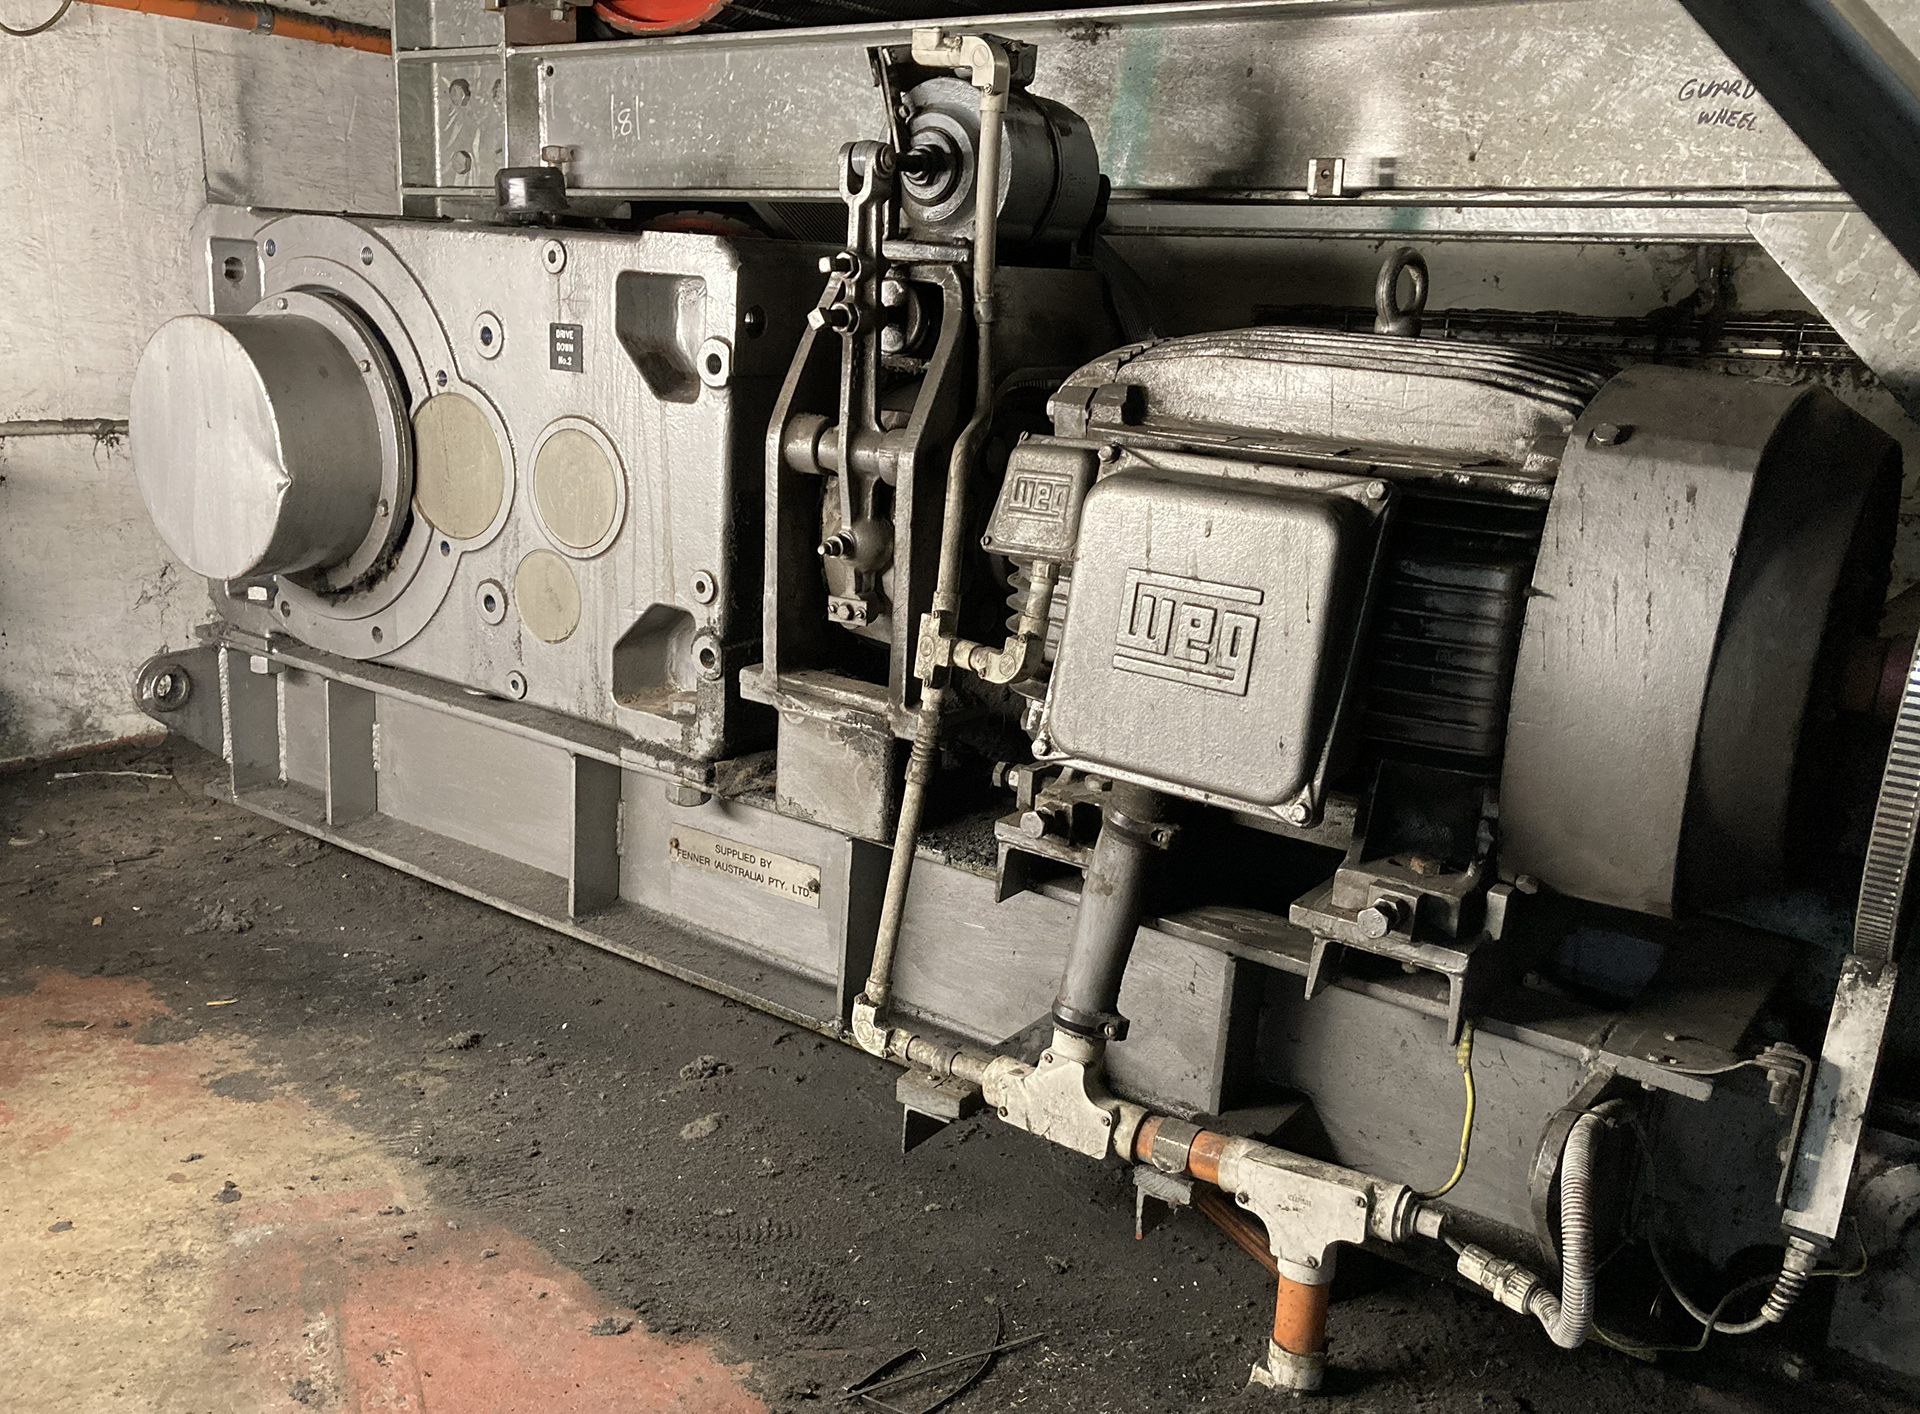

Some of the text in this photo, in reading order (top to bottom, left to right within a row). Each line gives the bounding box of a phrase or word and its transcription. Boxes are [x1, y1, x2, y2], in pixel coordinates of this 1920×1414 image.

[1678, 79, 1756, 101] GUARD
[555, 329, 574, 339] DRIVE
[556, 342, 574, 352] DOWN
[558, 355, 572, 366] No.2
[714, 844, 773, 869] SUPPLIED BY
[676, 848, 812, 899] FENNER (AUSTRALIA) PTY. LTD.
